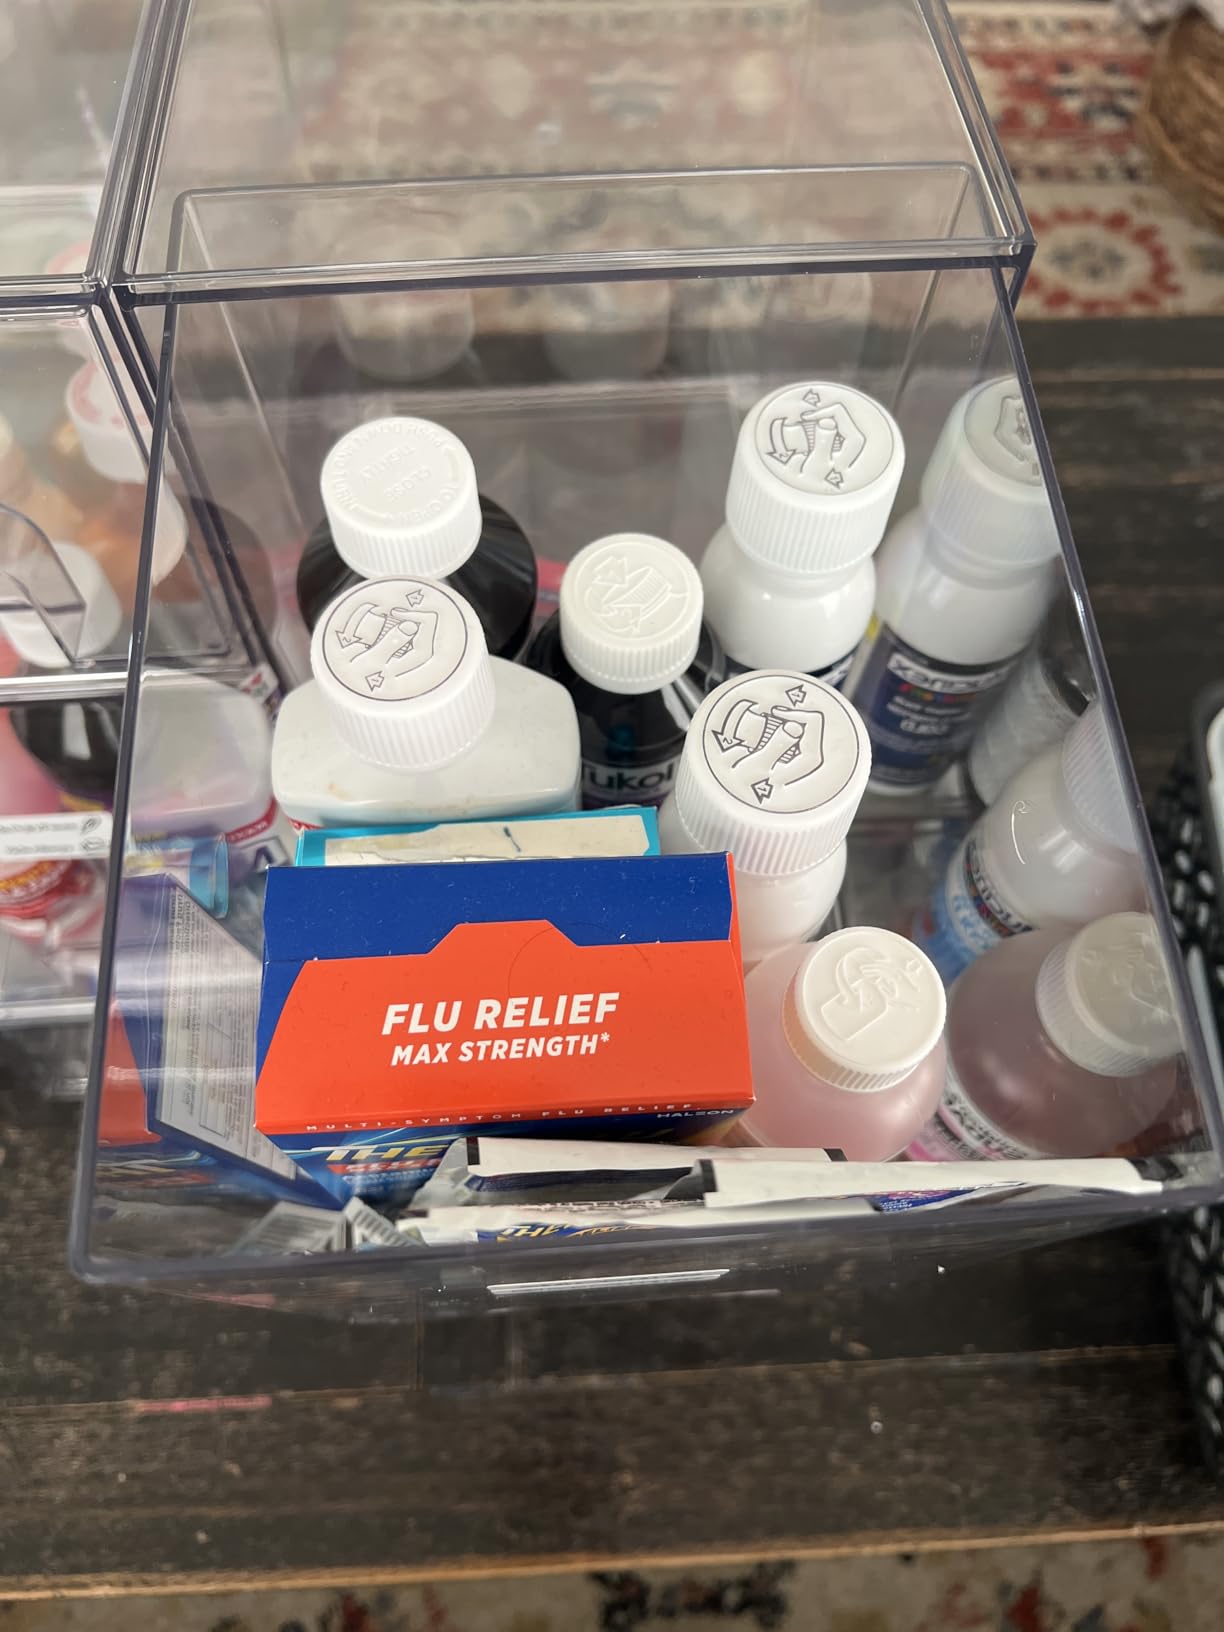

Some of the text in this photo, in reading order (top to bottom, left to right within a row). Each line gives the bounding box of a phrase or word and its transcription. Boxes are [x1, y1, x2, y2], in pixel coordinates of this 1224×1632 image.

[381, 991, 621, 1036] FLU RELIEF
[390, 1042, 450, 1068] MAX
[306, 1113, 521, 1131] MULTI-SYMPTOM
[604, 1103, 692, 1114] RELIEF
